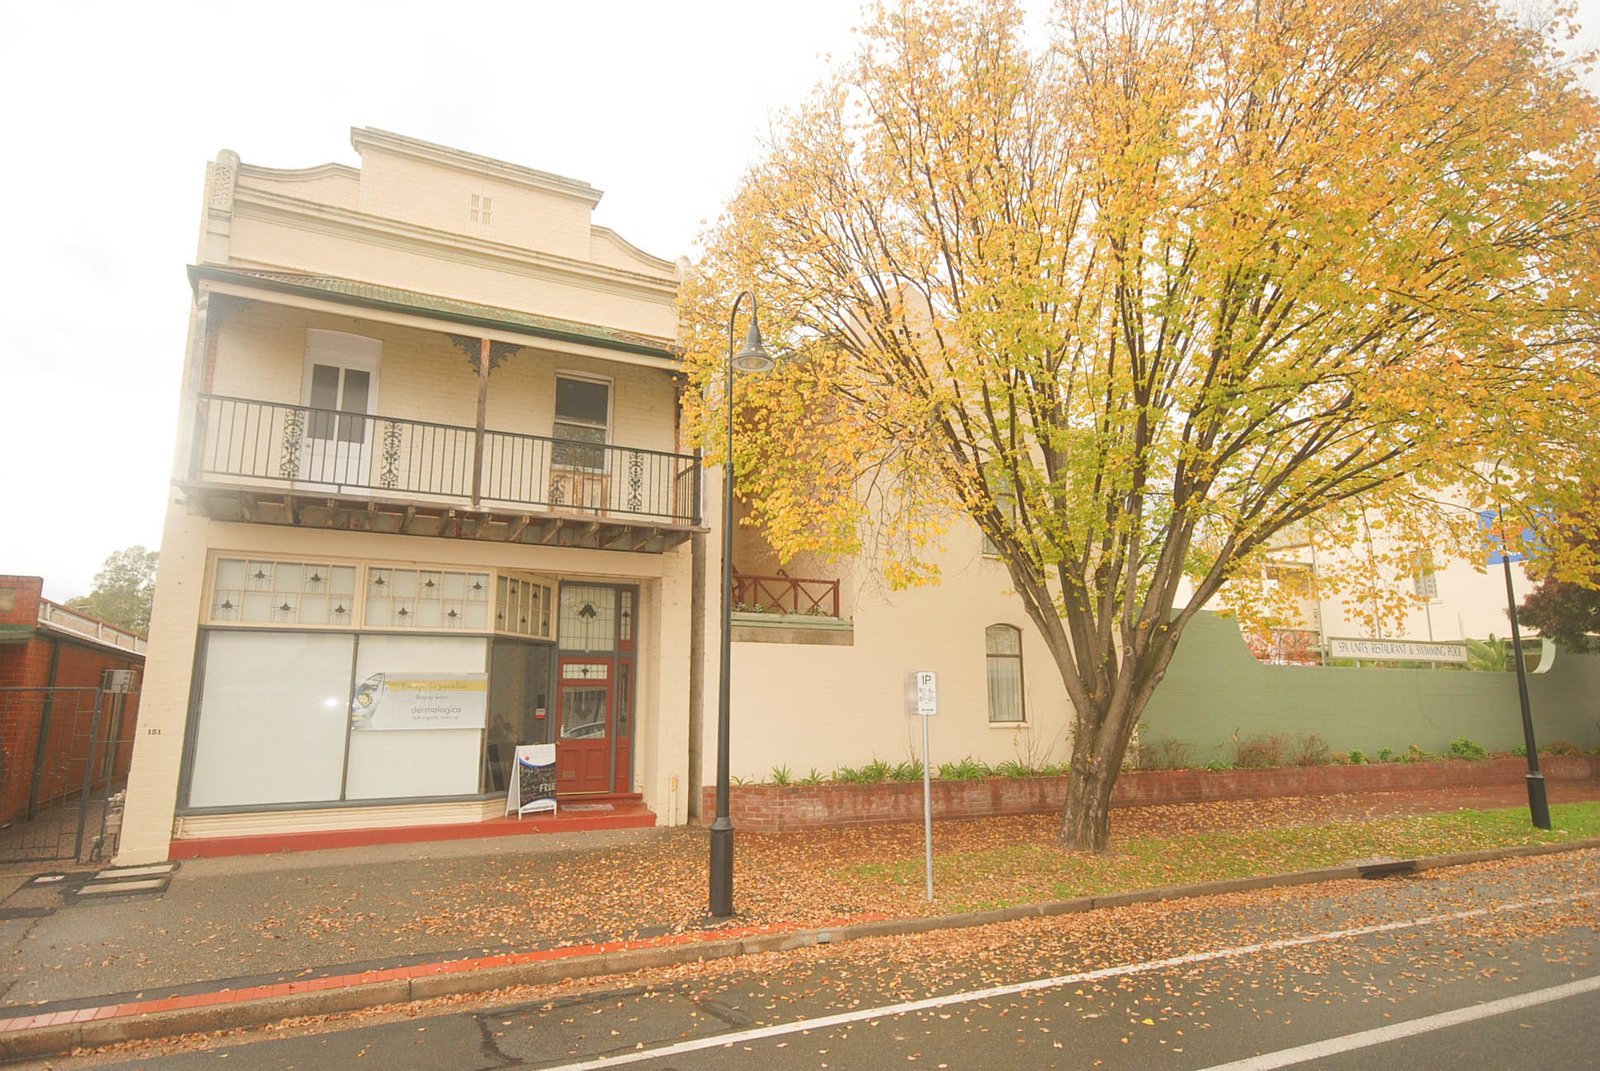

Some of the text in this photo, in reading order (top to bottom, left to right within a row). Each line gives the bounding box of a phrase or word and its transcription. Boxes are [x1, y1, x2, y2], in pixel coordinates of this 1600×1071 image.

[1338, 642, 1350, 652] SPA
[1350, 642, 1368, 653] UNITS
[1371, 643, 1406, 655] RESTAURANT
[1415, 645, 1446, 657] SWIMMING
[1447, 646, 1464, 658] POOL
[921, 674, 932, 685] 1P
[411, 706, 462, 714] dermalogica
[148, 728, 161, 736] 151
[540, 783, 556, 792] FREE
